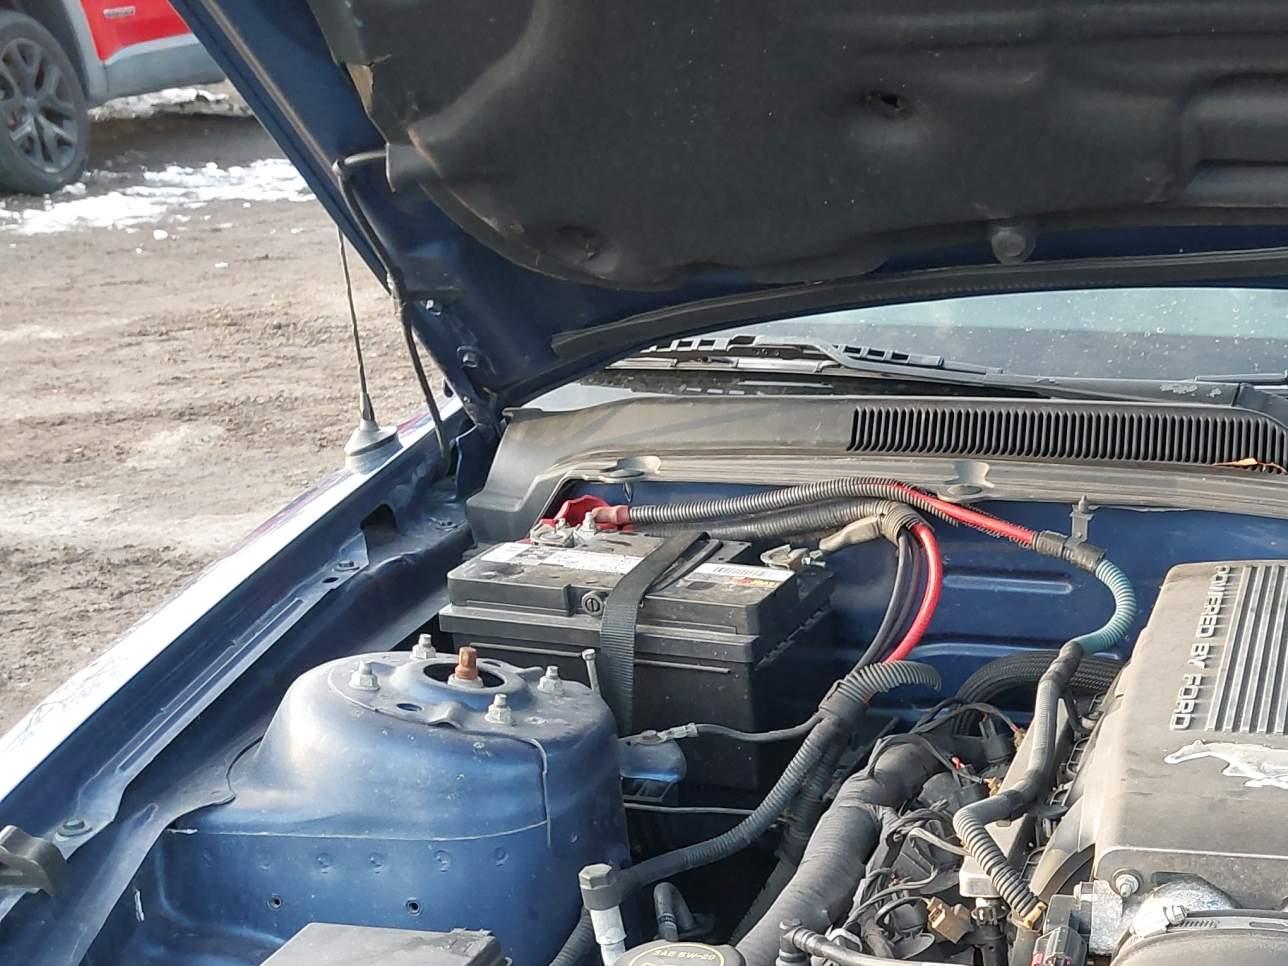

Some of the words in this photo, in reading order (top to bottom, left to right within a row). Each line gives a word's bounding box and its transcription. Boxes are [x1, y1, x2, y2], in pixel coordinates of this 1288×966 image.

[1196, 565, 1230, 637] POWERED
[1188, 643, 1210, 669] BY
[1169, 673, 1202, 730] FORD
